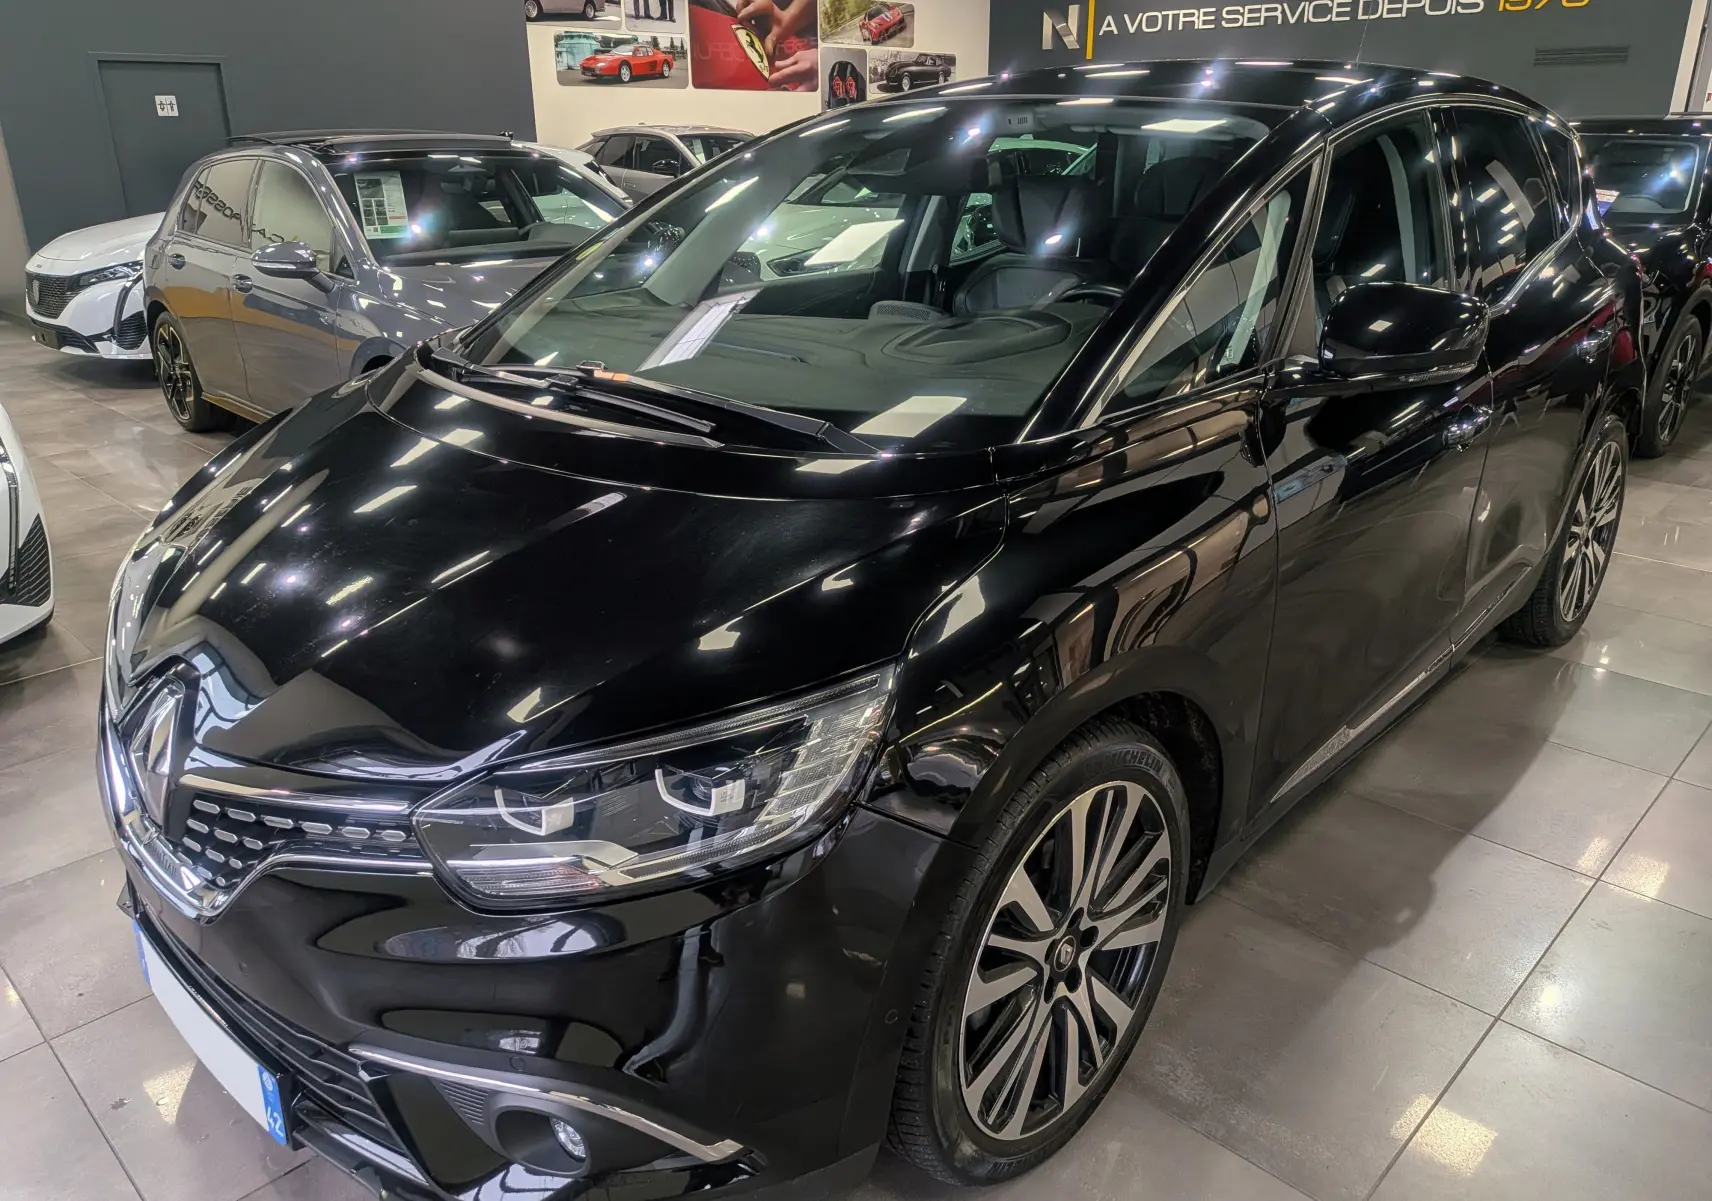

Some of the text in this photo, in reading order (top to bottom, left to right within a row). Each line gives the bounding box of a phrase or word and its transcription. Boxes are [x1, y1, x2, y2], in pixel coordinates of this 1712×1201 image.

[1099, 15, 1118, 36] A
[1123, 8, 1216, 34] VOTRE
[1221, 0, 1350, 28] SERVICE
[1358, 0, 1485, 20] DEPUIS
[1104, 748, 1164, 776] MICHELIN
[267, 1105, 285, 1137] 42
